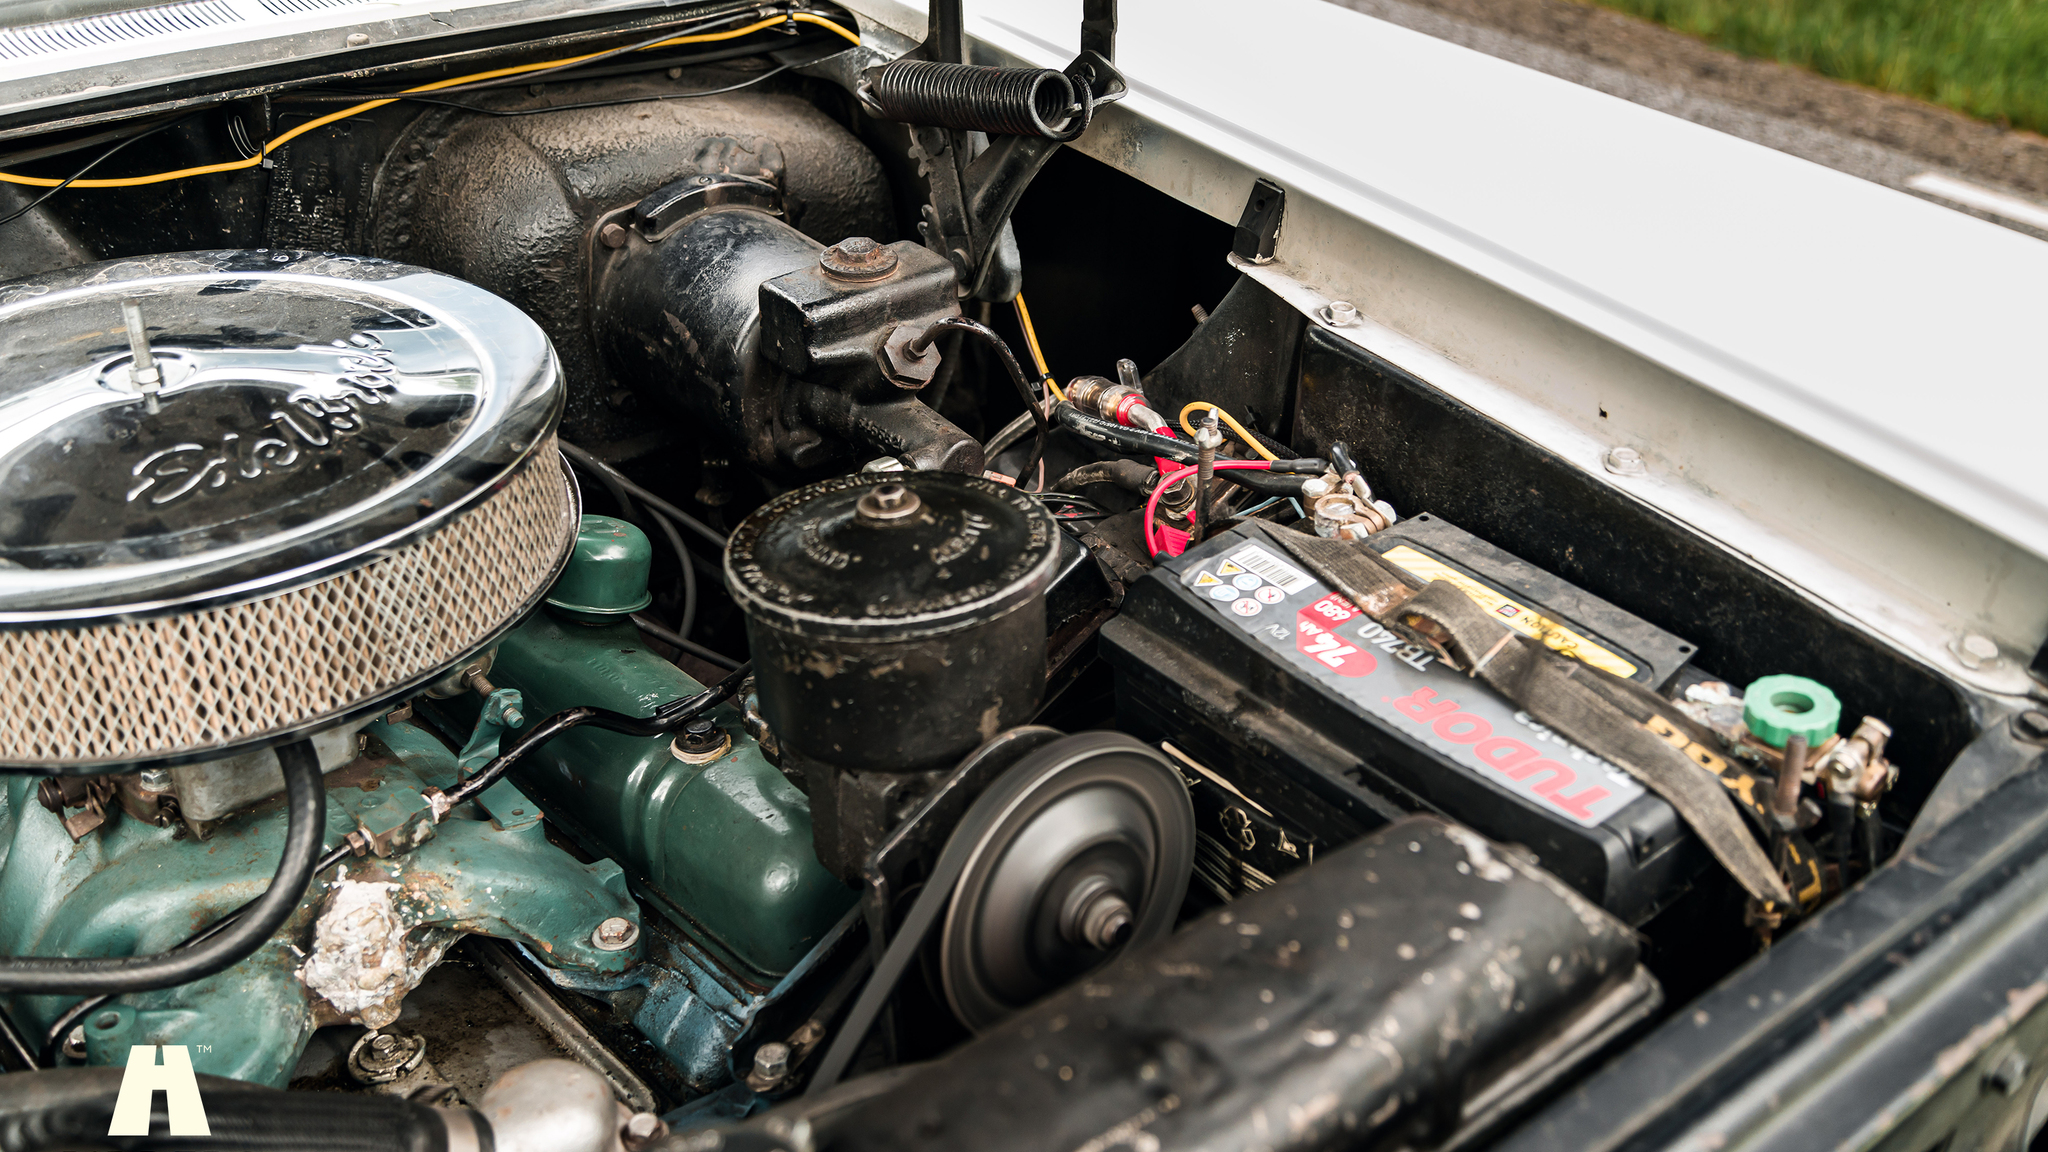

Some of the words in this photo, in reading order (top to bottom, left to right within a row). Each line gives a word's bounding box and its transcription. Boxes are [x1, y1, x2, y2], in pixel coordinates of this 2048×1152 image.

[127, 333, 394, 504] Edelbrock
[1265, 623, 1291, 640] 12V
[1313, 600, 1351, 621] 680
[1357, 622, 1434, 672] TB740
[1392, 685, 1612, 821] TUDOR
